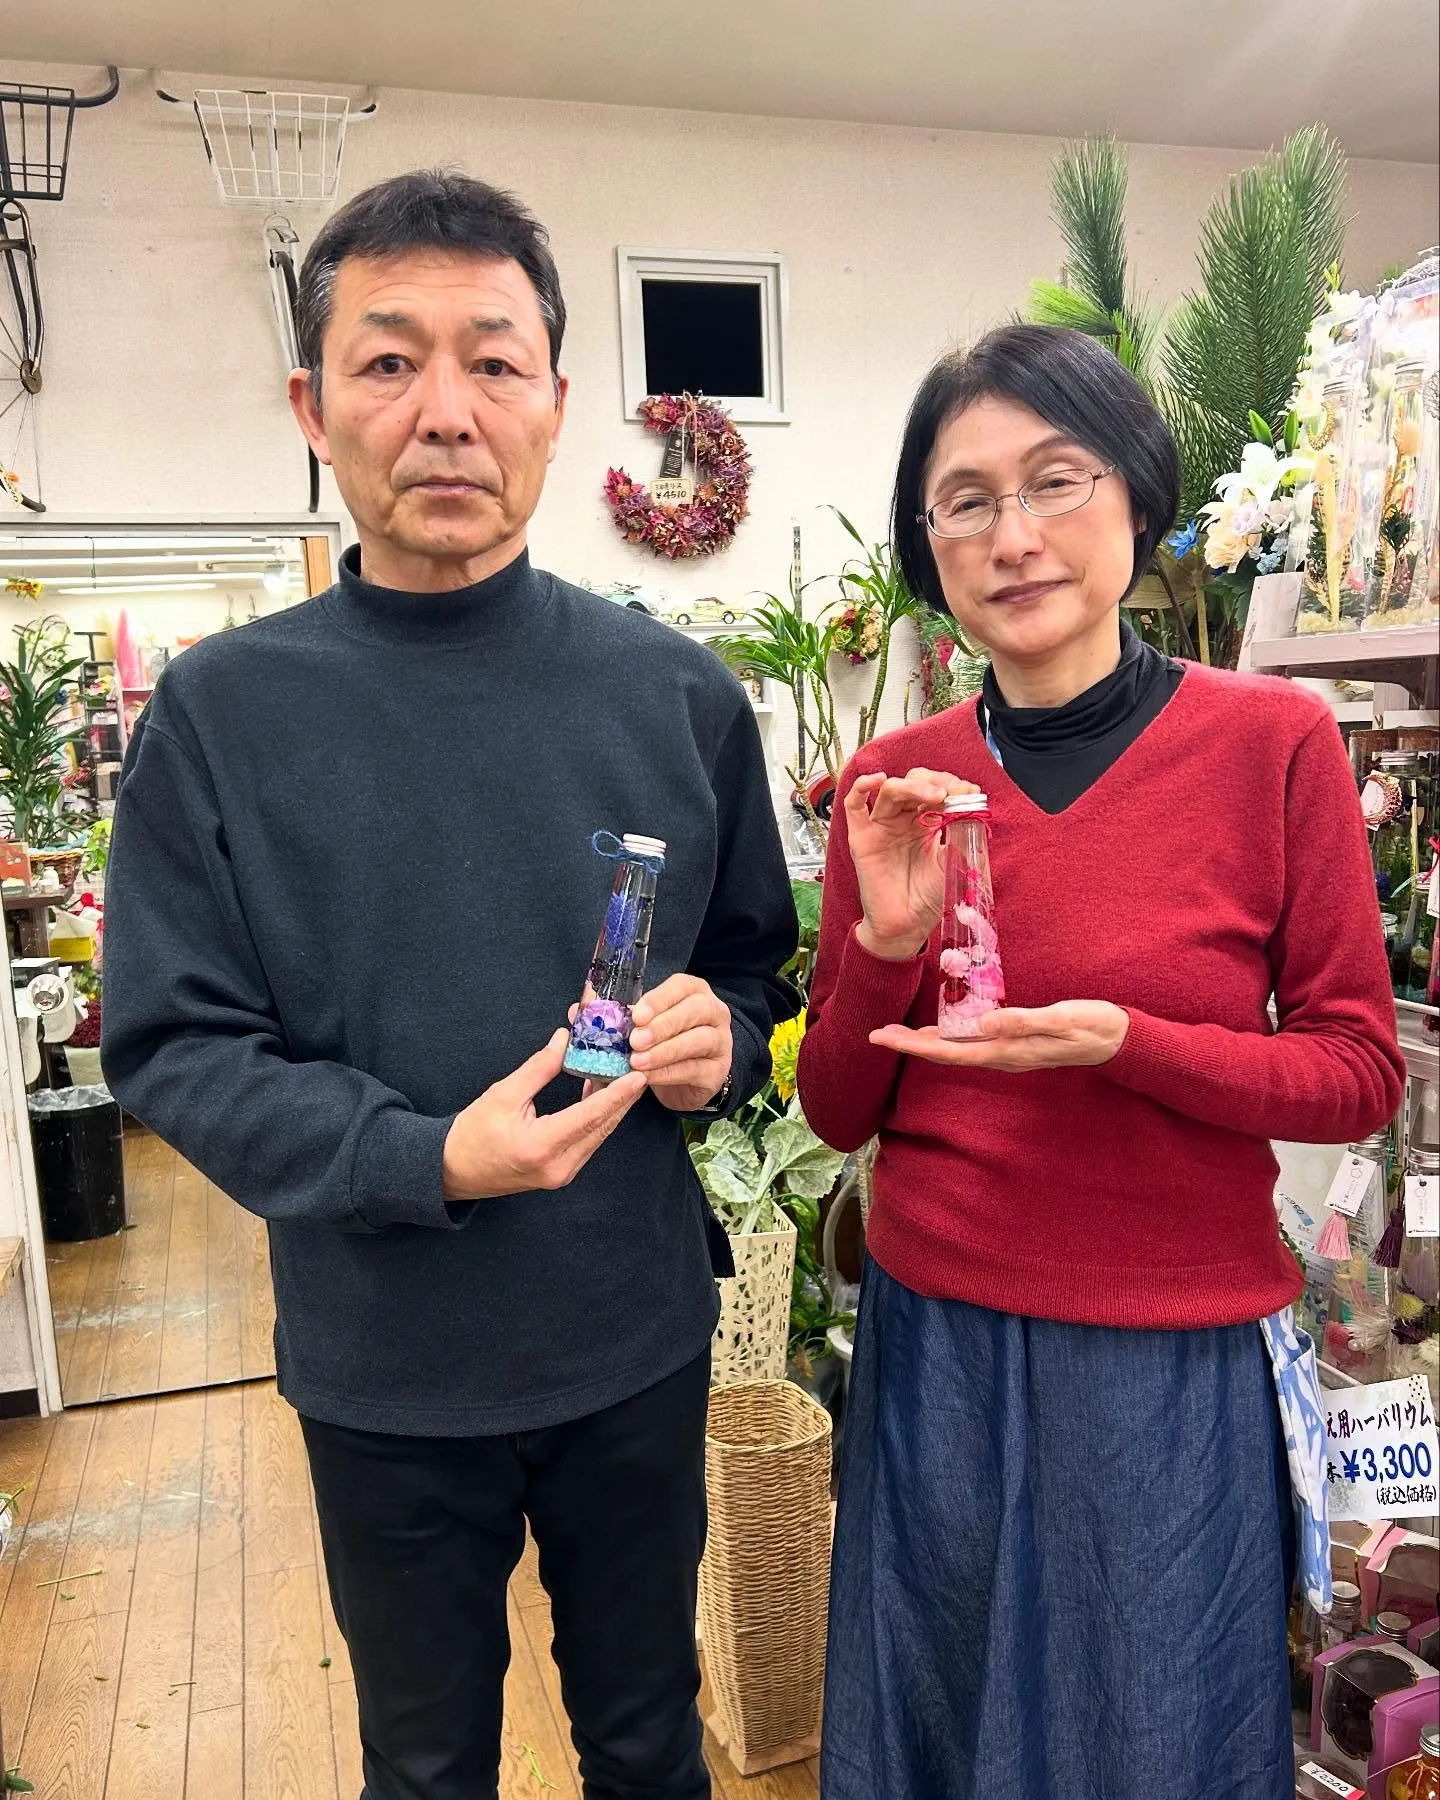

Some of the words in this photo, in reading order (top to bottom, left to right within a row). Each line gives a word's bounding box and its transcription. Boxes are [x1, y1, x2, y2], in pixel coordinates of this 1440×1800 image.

[655, 490, 687, 500] ¥4510
[1339, 1441, 1432, 1484] ¥3,300
[1376, 1483, 1437, 1505] (税込価格)
[1310, 1767, 1349, 1792] ¥2200
